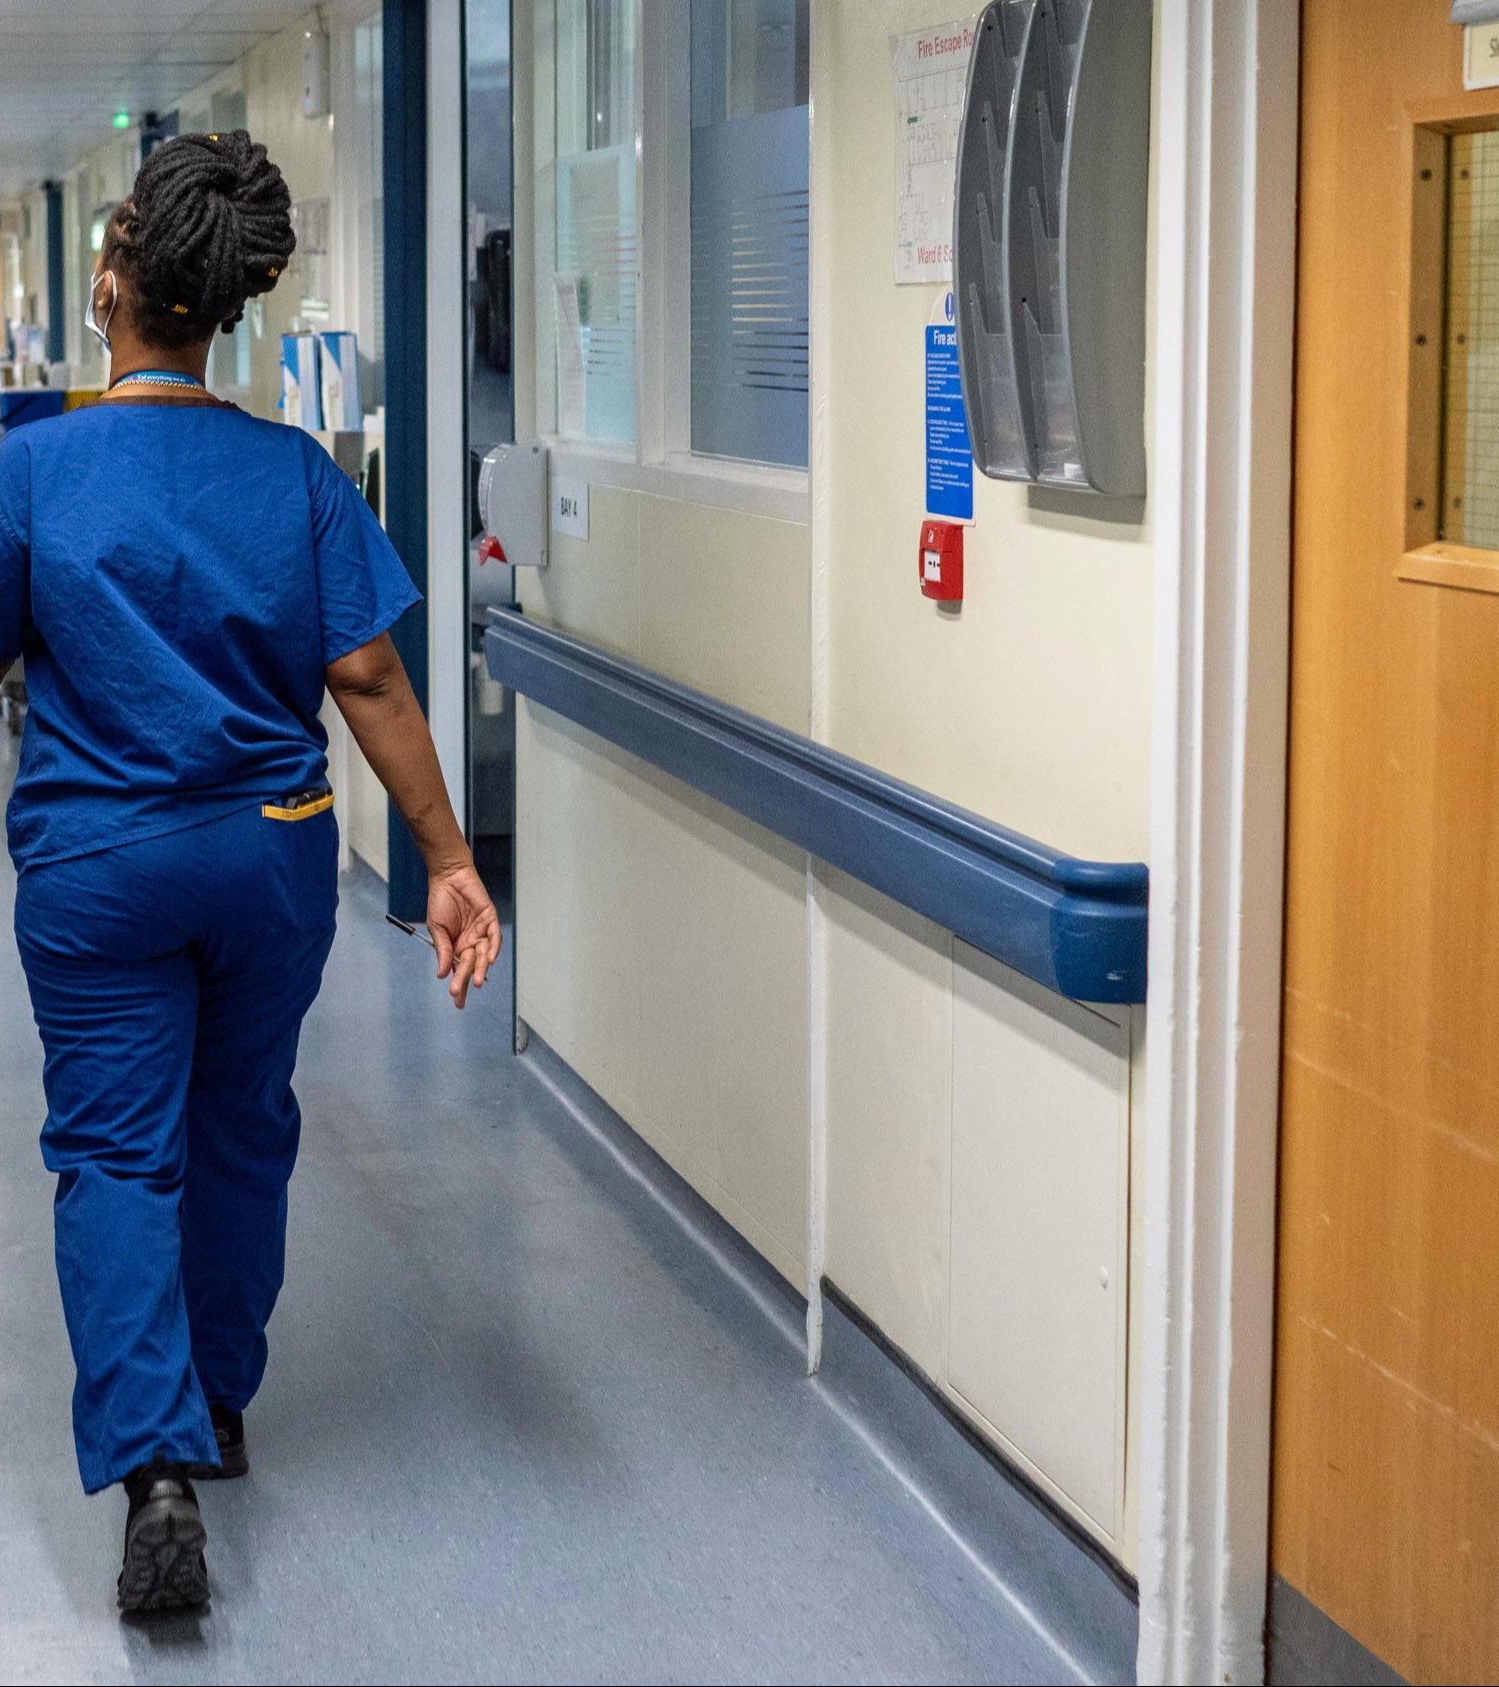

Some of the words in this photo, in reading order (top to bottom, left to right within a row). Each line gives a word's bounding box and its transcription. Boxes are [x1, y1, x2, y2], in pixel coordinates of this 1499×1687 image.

[918, 40, 933, 59] Fire
[934, 36, 962, 55] Escape
[963, 28, 974, 48] Ro
[918, 246, 936, 264] Ward
[937, 245, 942, 263] 6
[933, 329, 946, 346] Fire
[561, 497, 572, 517] BAY
[573, 500, 577, 518] 4
